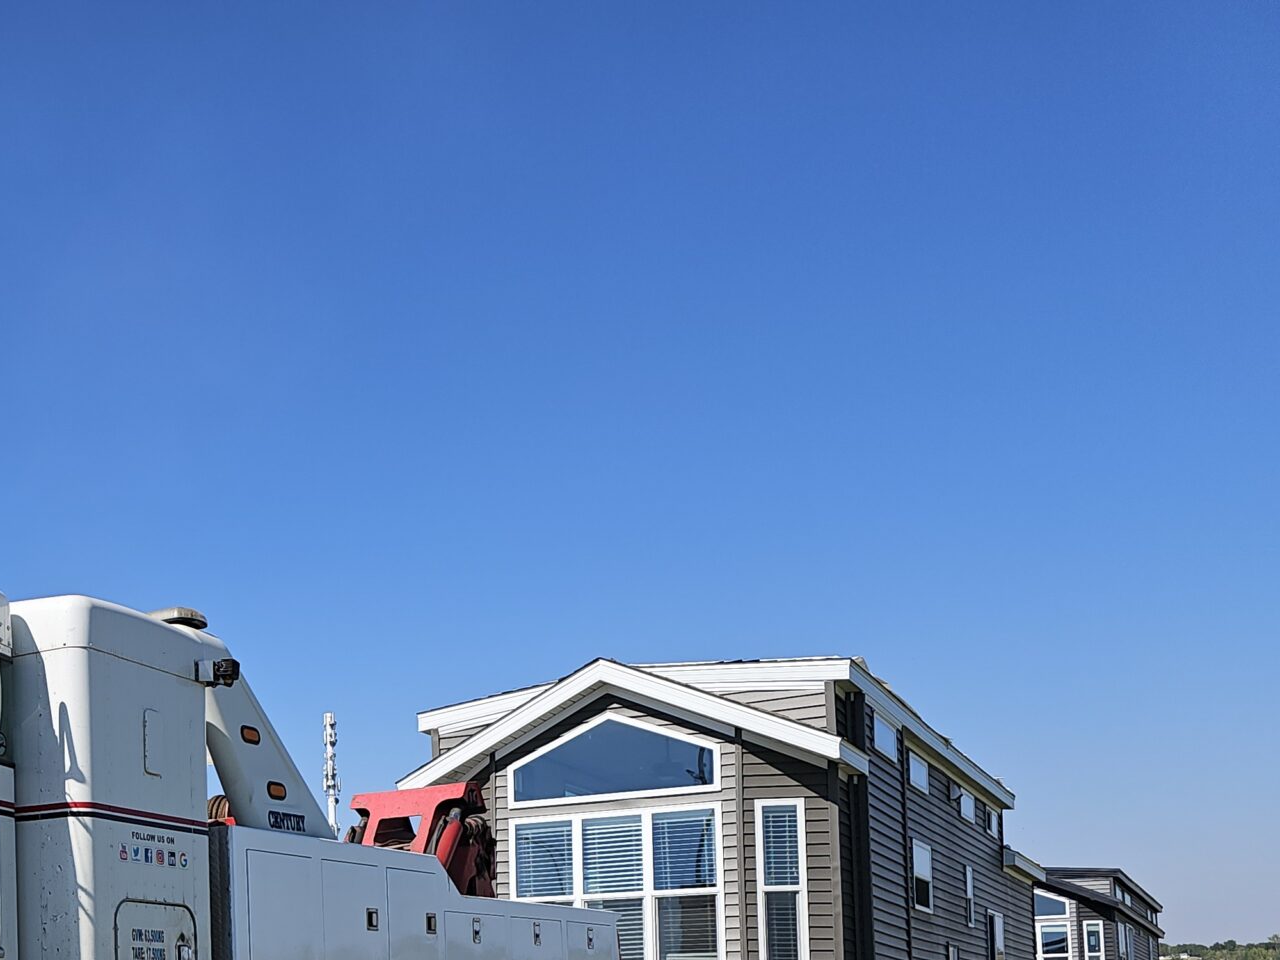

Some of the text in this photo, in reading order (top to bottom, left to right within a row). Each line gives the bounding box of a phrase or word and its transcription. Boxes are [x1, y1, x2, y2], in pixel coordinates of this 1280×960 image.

[268, 810, 306, 832] CENTURY
[131, 831, 175, 845] FOLLOW US ON
